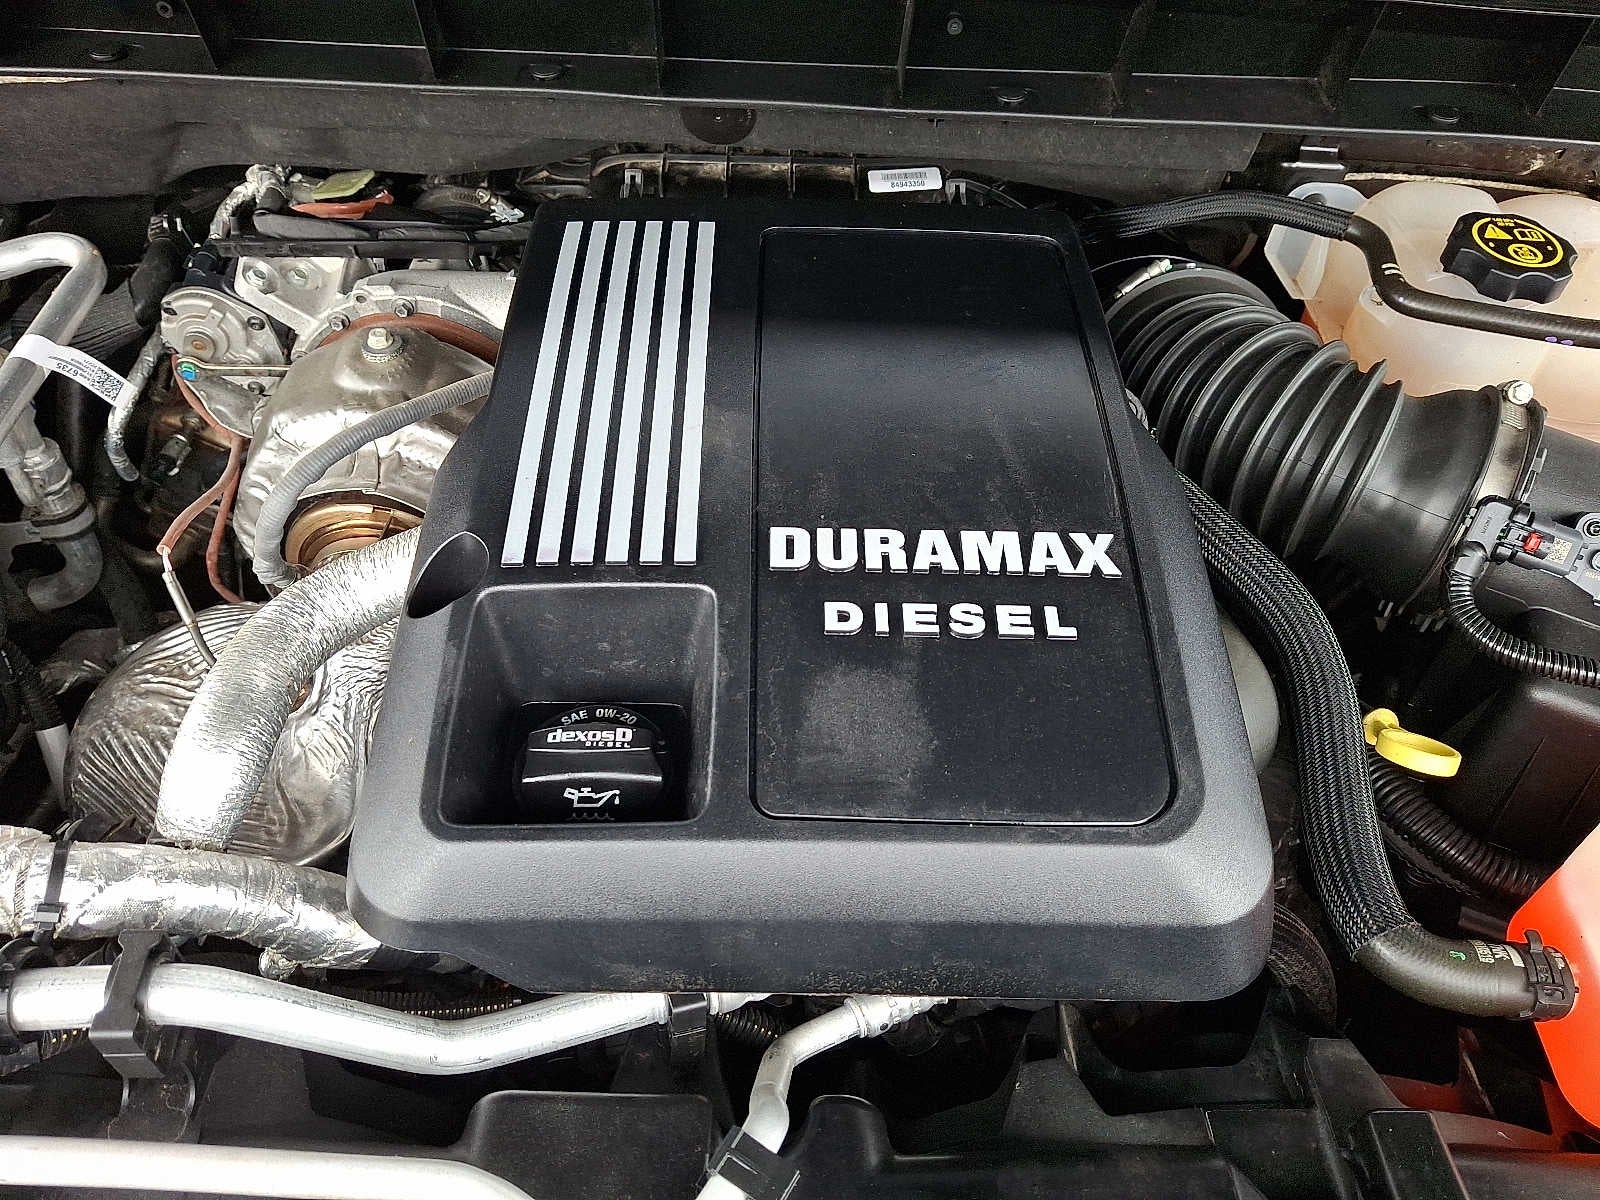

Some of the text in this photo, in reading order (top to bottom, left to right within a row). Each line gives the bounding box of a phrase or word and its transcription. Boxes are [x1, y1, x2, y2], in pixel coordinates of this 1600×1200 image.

[768, 526, 1122, 578] DURAMAX
[823, 600, 1078, 640] DIESEL
[561, 708, 637, 725] SAE 0W-20
